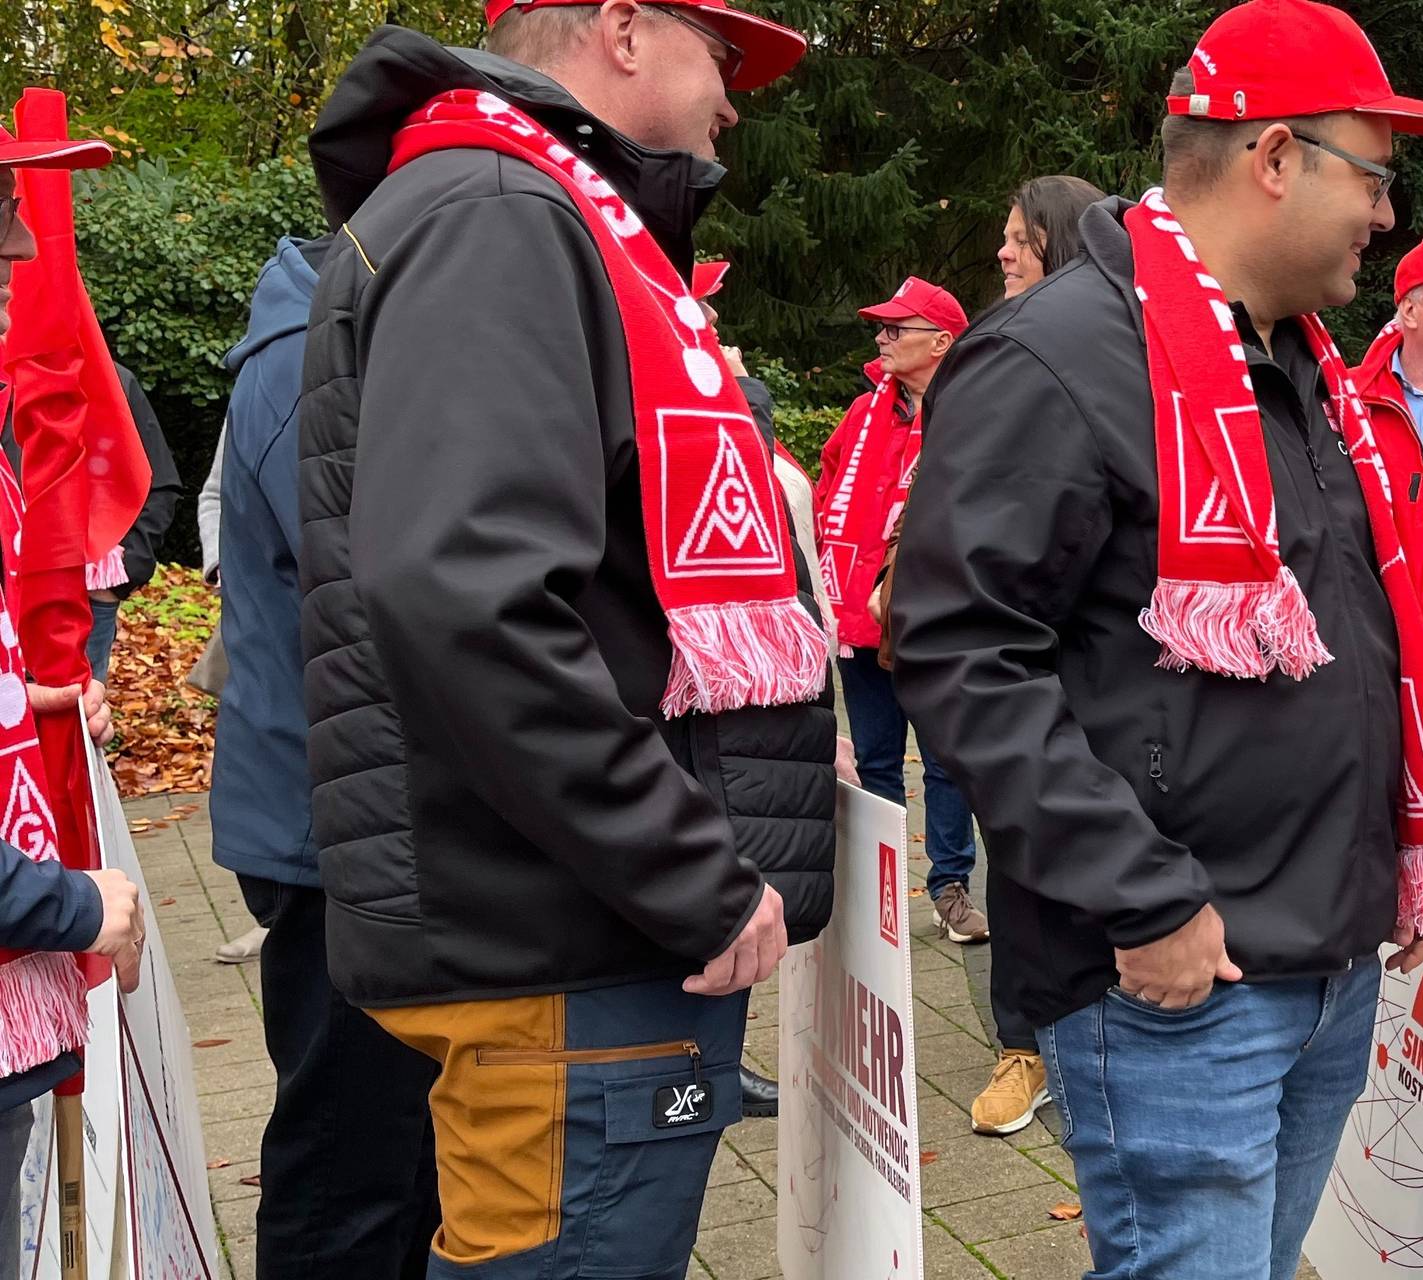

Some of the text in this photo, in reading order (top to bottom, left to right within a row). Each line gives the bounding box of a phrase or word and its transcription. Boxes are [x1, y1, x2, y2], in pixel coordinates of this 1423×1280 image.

[691, 446, 773, 556] IGM
[840, 967, 908, 1128] MEHR
[862, 1098, 909, 1174] NOTWENDIG
